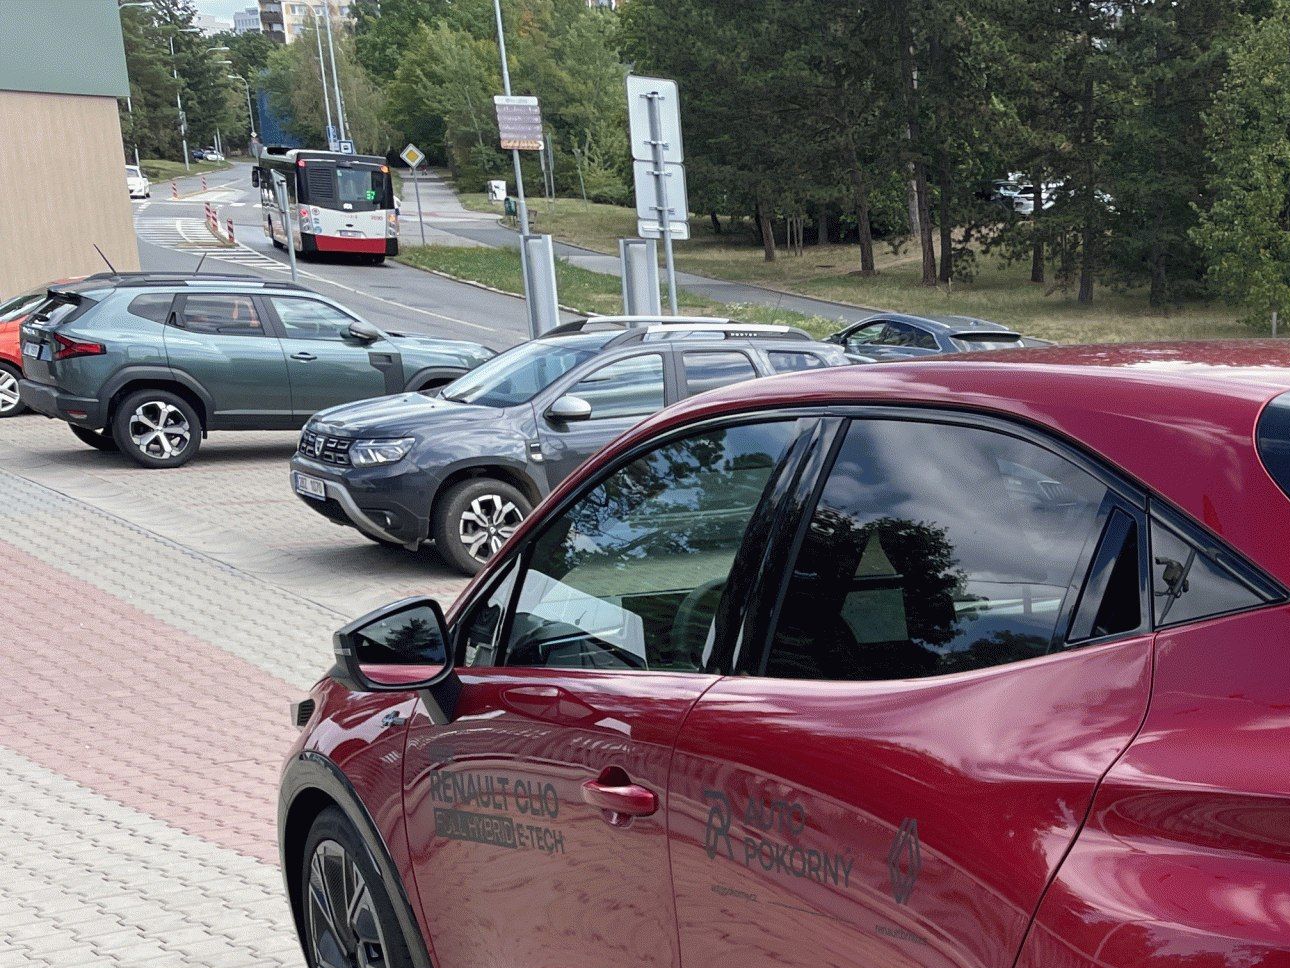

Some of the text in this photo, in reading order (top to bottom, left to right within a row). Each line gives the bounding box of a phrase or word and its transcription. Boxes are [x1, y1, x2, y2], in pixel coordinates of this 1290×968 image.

[430, 770, 559, 818] RENAULT CLIO
[743, 796, 804, 835] AUTO
[468, 818, 514, 846] HYBRID
[516, 823, 565, 854] E-TECH
[744, 836, 854, 888] POKORNÝ
